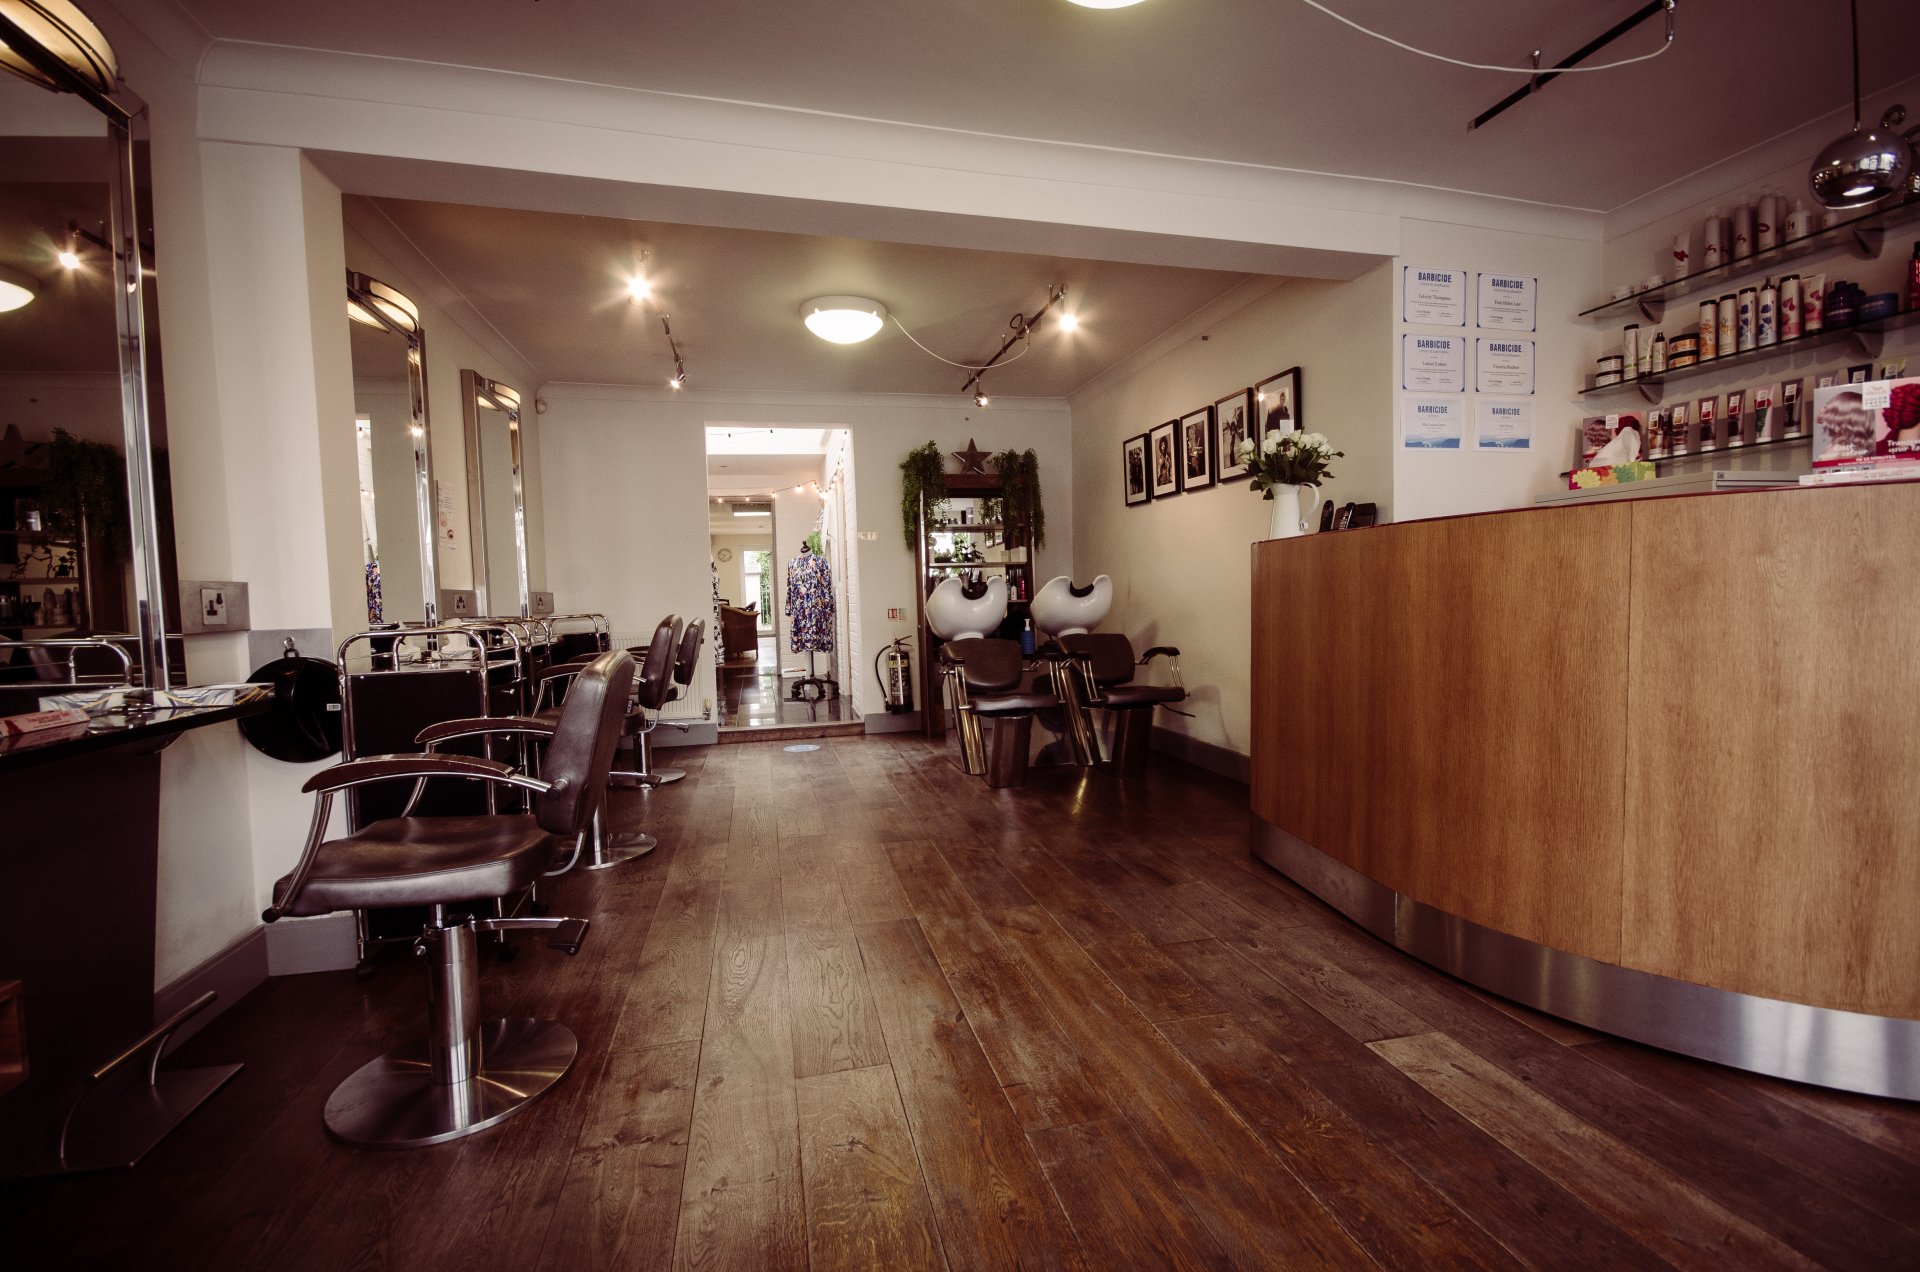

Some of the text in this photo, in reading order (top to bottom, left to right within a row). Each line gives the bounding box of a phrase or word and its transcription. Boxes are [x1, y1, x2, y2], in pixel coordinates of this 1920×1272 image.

[1418, 272, 1452, 283] BARBICIDE
[1491, 278, 1524, 289] BARBICIDE
[1417, 339, 1451, 349] BARBICIDE
[1489, 343, 1522, 353] BARBICIDE
[1417, 405, 1448, 414] BARBICIDE
[1491, 407, 1520, 416] BARBICIDE
